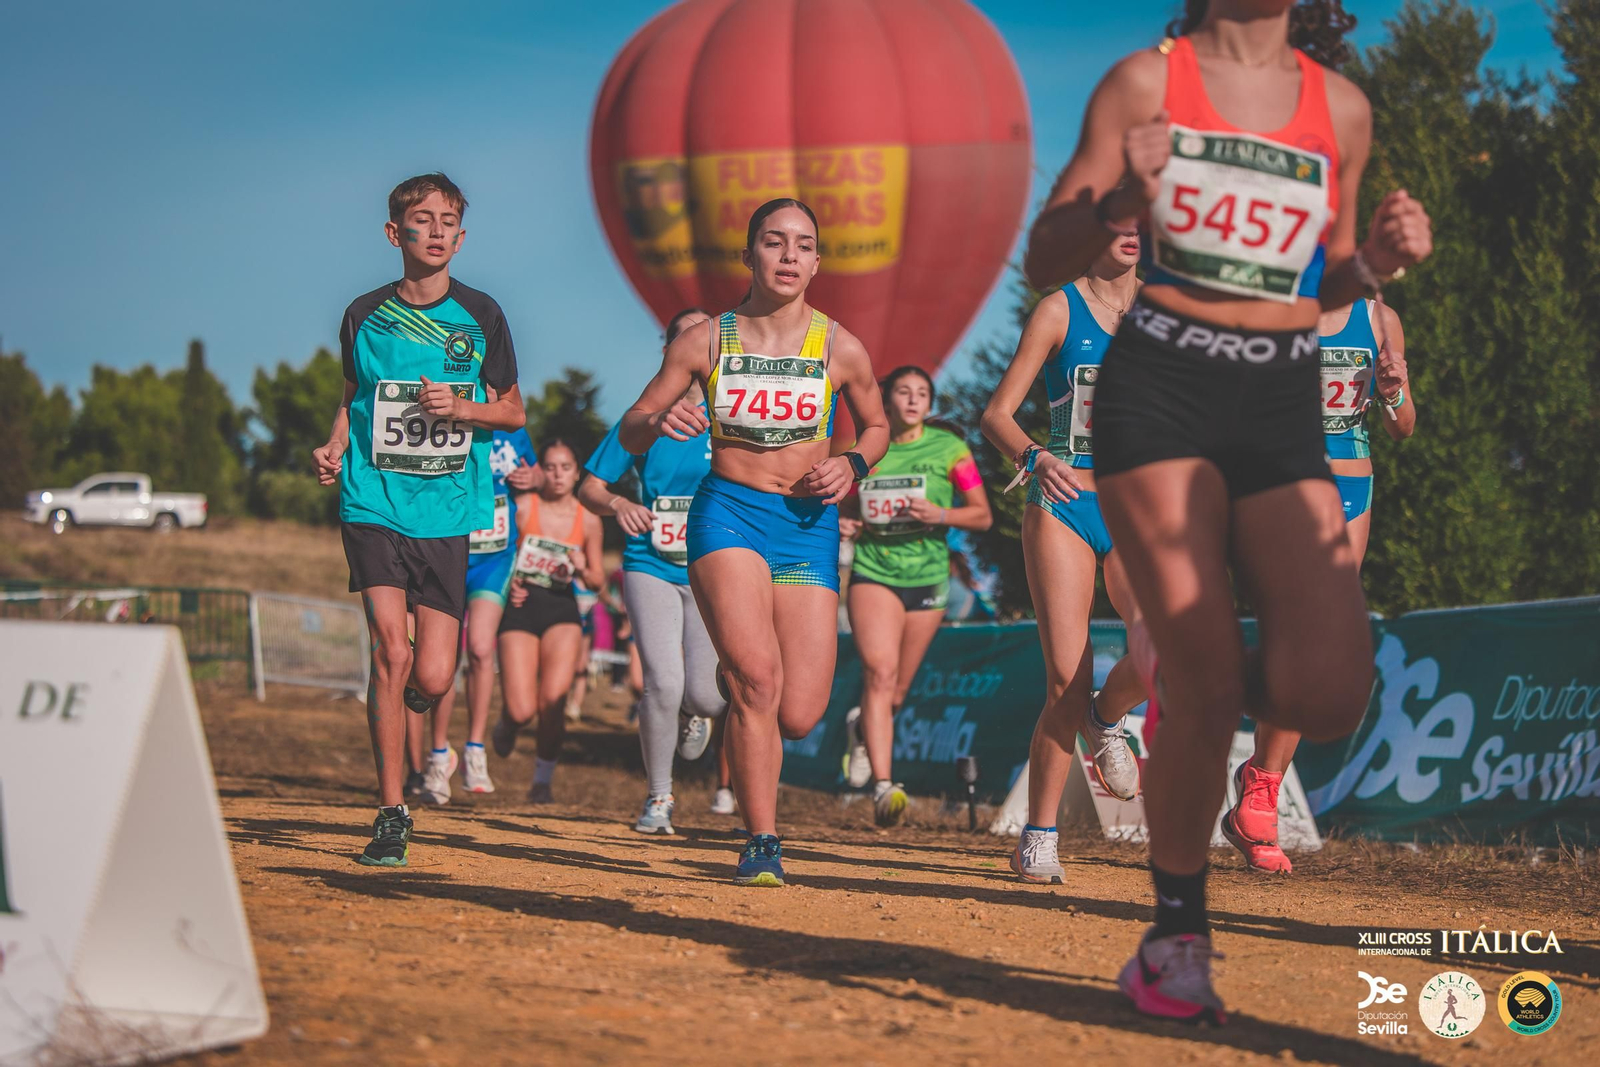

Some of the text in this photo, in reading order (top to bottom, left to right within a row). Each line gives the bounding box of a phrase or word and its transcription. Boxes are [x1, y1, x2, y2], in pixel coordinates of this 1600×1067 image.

[717, 151, 886, 192] FUERZAS
[1166, 184, 1310, 254] 5457
[1175, 325, 1277, 364] PRO
[1320, 352, 1349, 362] LICA
[727, 388, 817, 421] 7456
[1320, 380, 1364, 408] 27
[384, 416, 466, 448] 5965
[17, 680, 91, 723] DE
